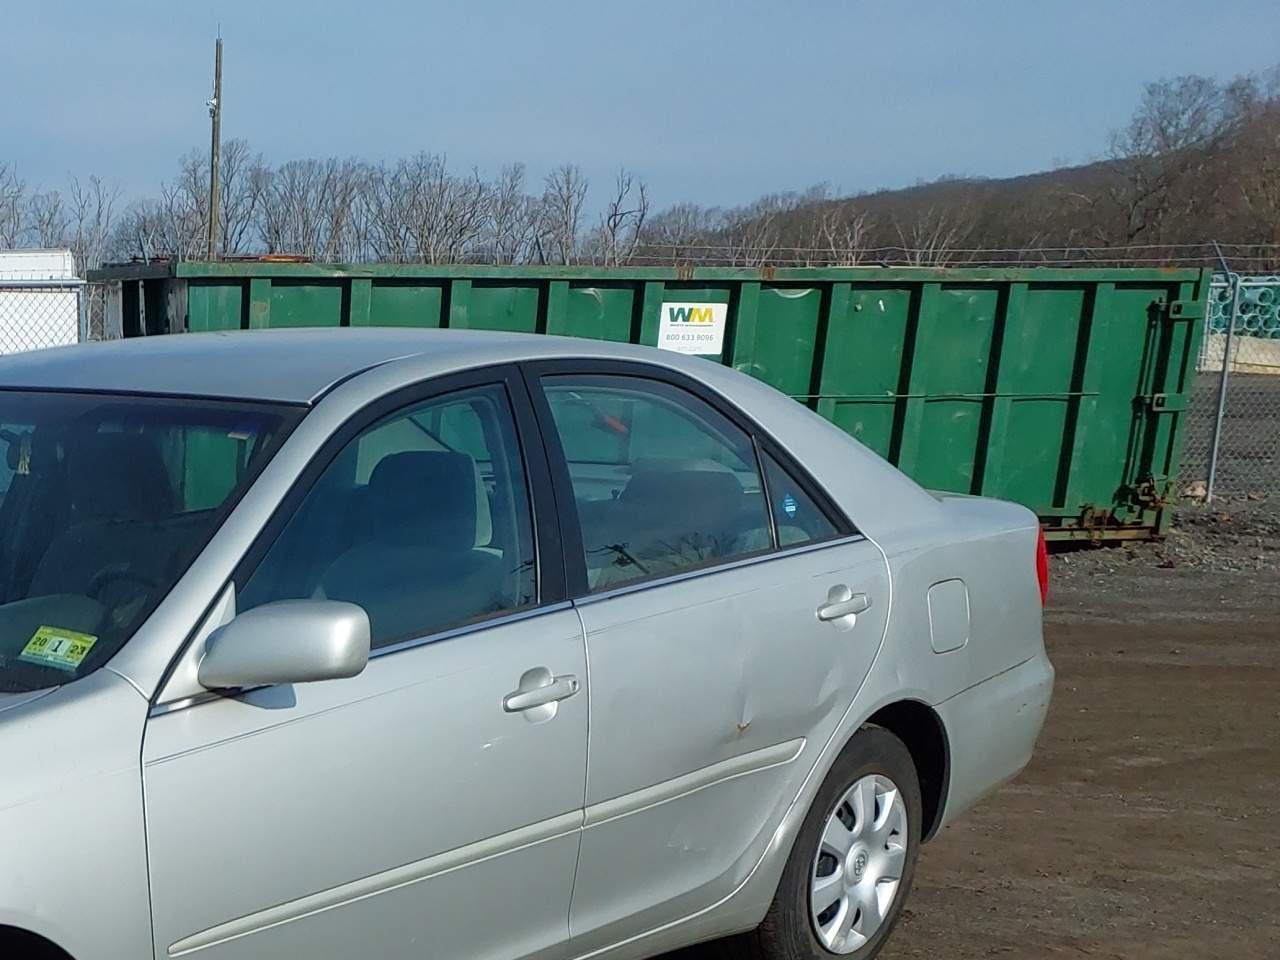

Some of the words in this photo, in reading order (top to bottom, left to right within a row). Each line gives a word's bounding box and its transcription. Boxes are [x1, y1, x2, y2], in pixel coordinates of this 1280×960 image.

[669, 307, 714, 323] WM
[32, 636, 48, 647] 20
[51, 639, 64, 653] 1
